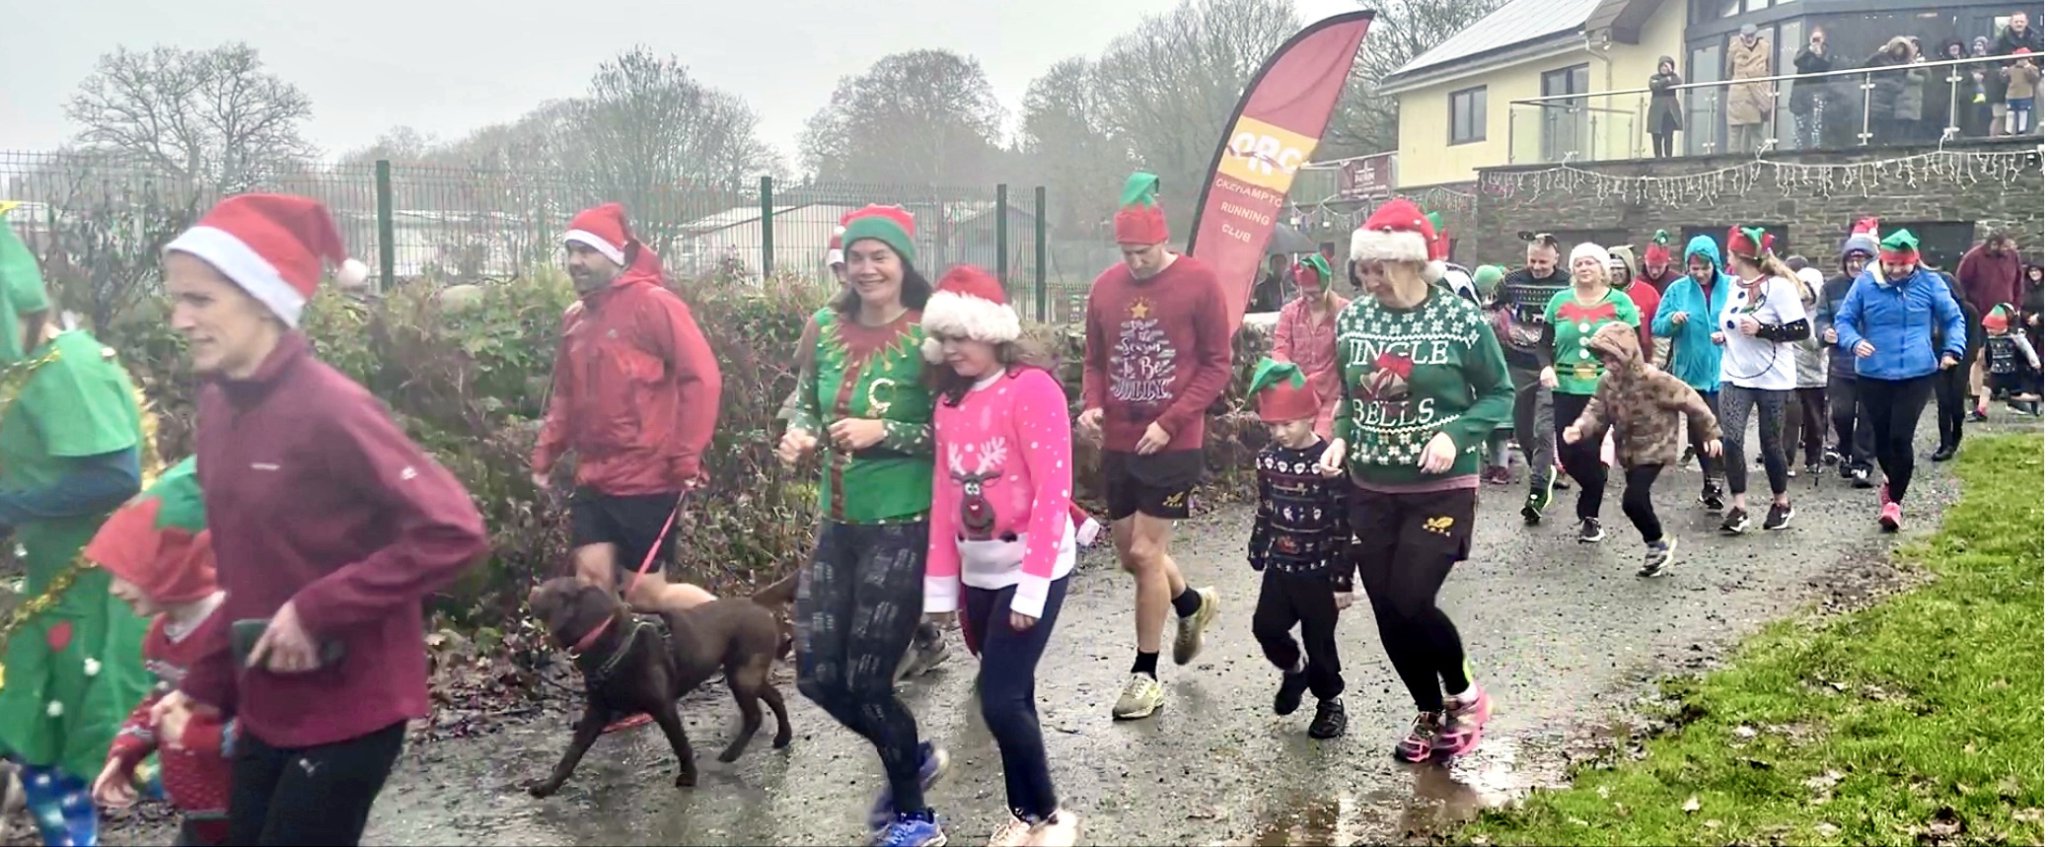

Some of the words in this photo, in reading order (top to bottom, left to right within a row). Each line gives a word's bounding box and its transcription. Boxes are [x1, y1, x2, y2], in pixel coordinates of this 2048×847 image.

[1232, 131, 1302, 176] ORC
[1215, 178, 1284, 209] OKEHAMPTO
[1220, 201, 1271, 226] RUNNING
[1221, 223, 1253, 244] CLUB
[1352, 398, 1435, 427] BELLS
